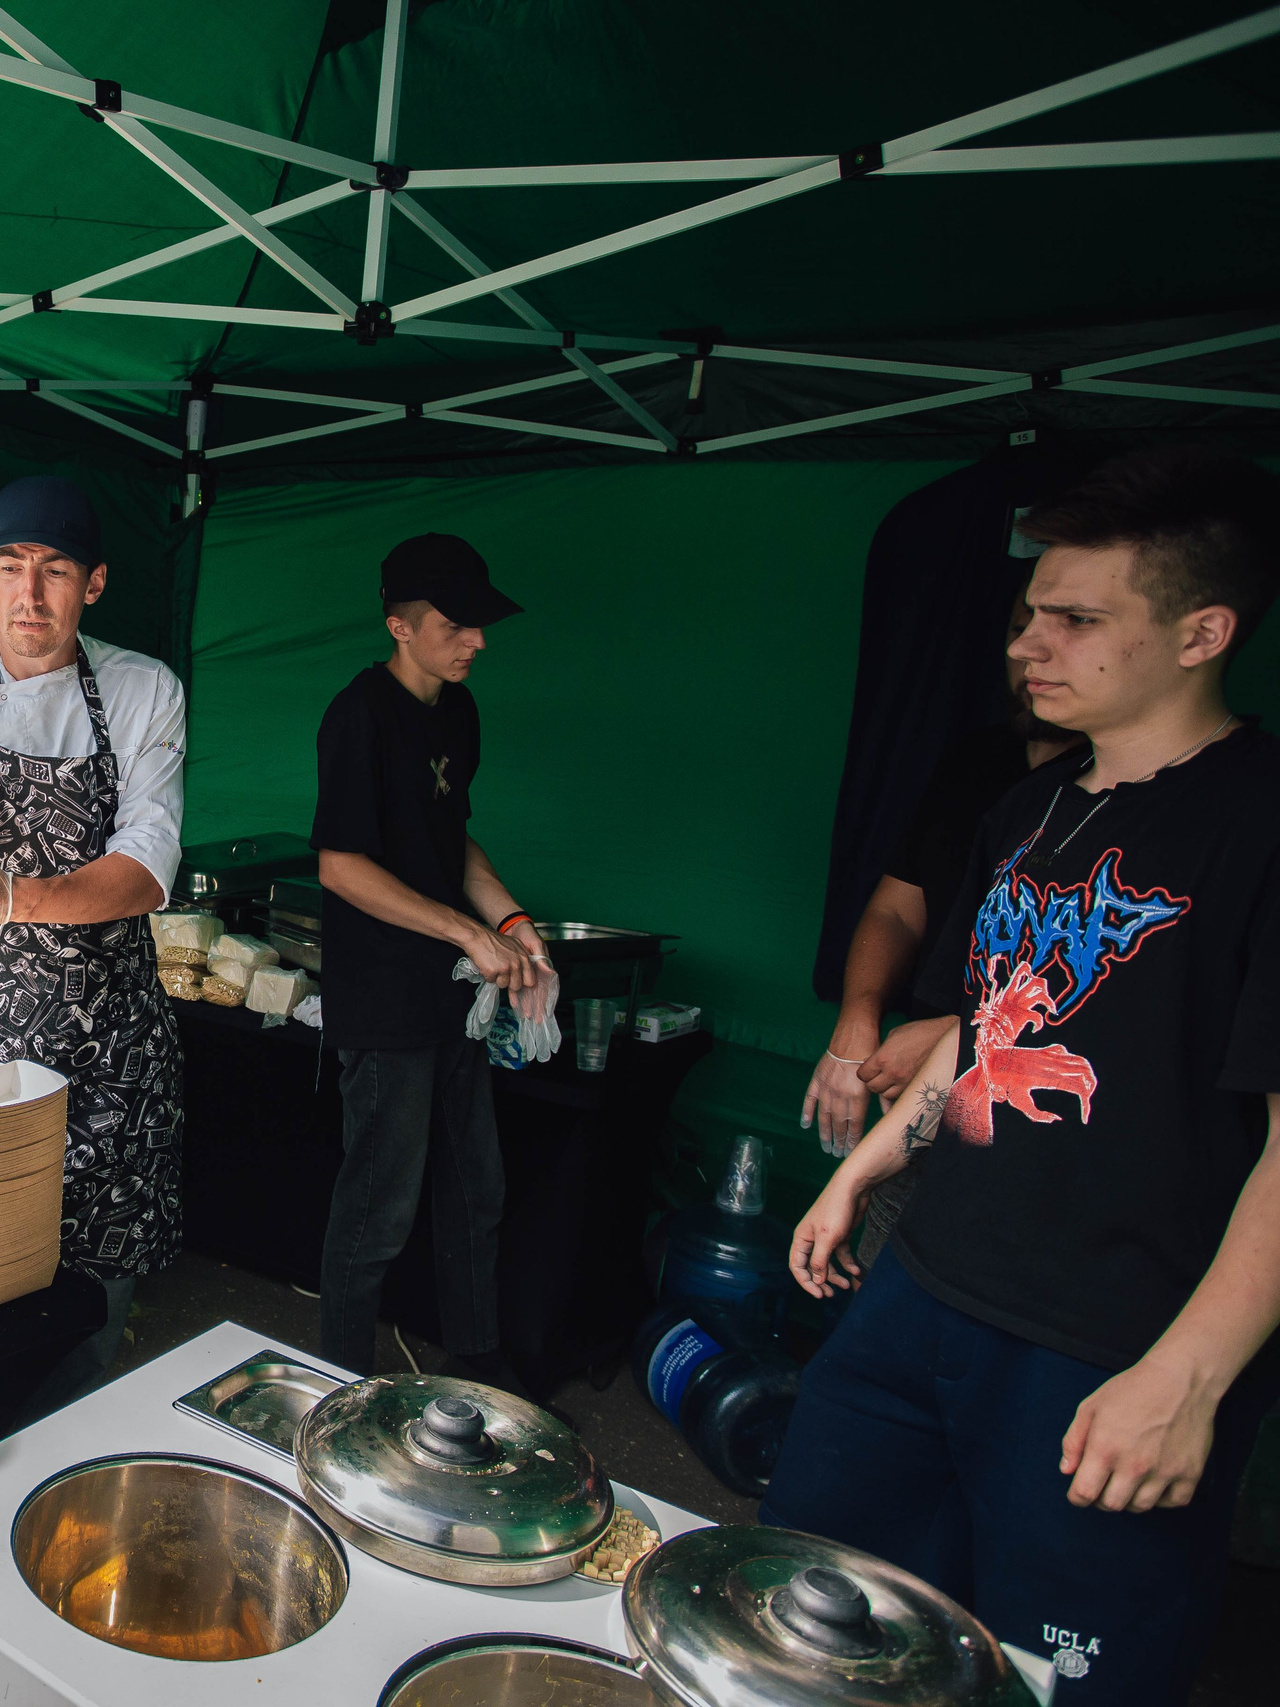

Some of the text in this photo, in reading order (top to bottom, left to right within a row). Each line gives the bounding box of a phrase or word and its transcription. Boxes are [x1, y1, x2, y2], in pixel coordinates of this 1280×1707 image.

[1017, 434, 1028, 442] 15
[661, 1335, 694, 1375] ИСТОЧНИК
[1043, 1624, 1101, 1655] UCLA
